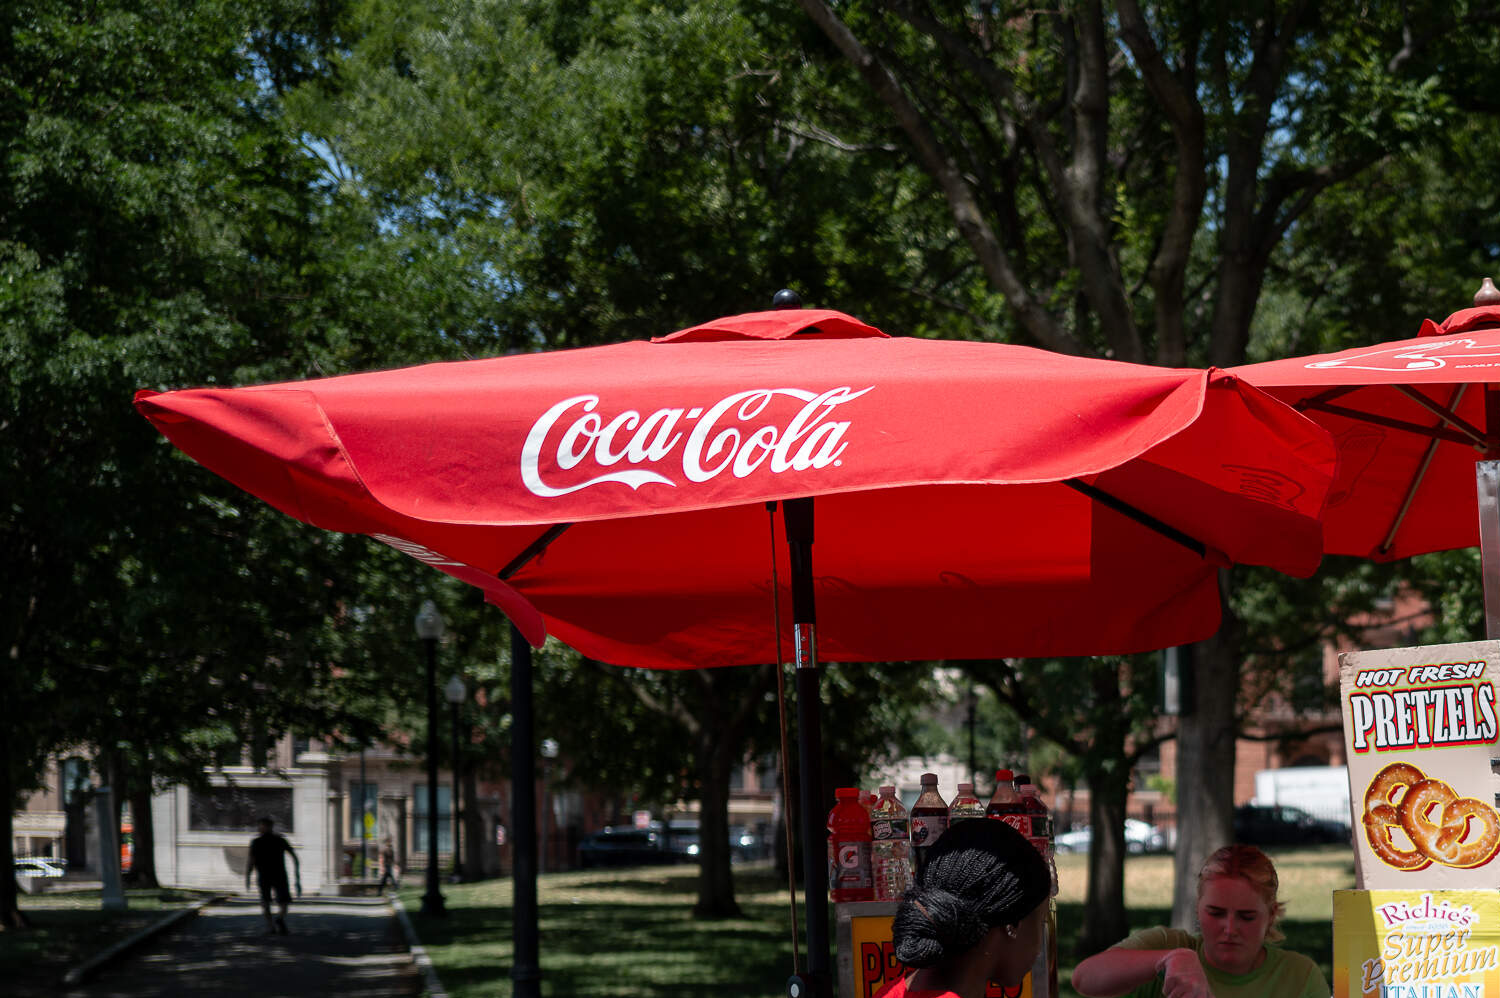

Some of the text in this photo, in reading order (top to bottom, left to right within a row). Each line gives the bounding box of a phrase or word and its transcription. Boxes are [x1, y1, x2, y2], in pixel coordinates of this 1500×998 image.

[521, 385, 875, 498] Coca-Cola
[1355, 661, 1487, 688] HOT FRESH
[1349, 682, 1500, 752] PRETZELS
[1379, 895, 1472, 926] Richie's
[1383, 928, 1470, 960] Super
[1364, 947, 1497, 990] Premium
